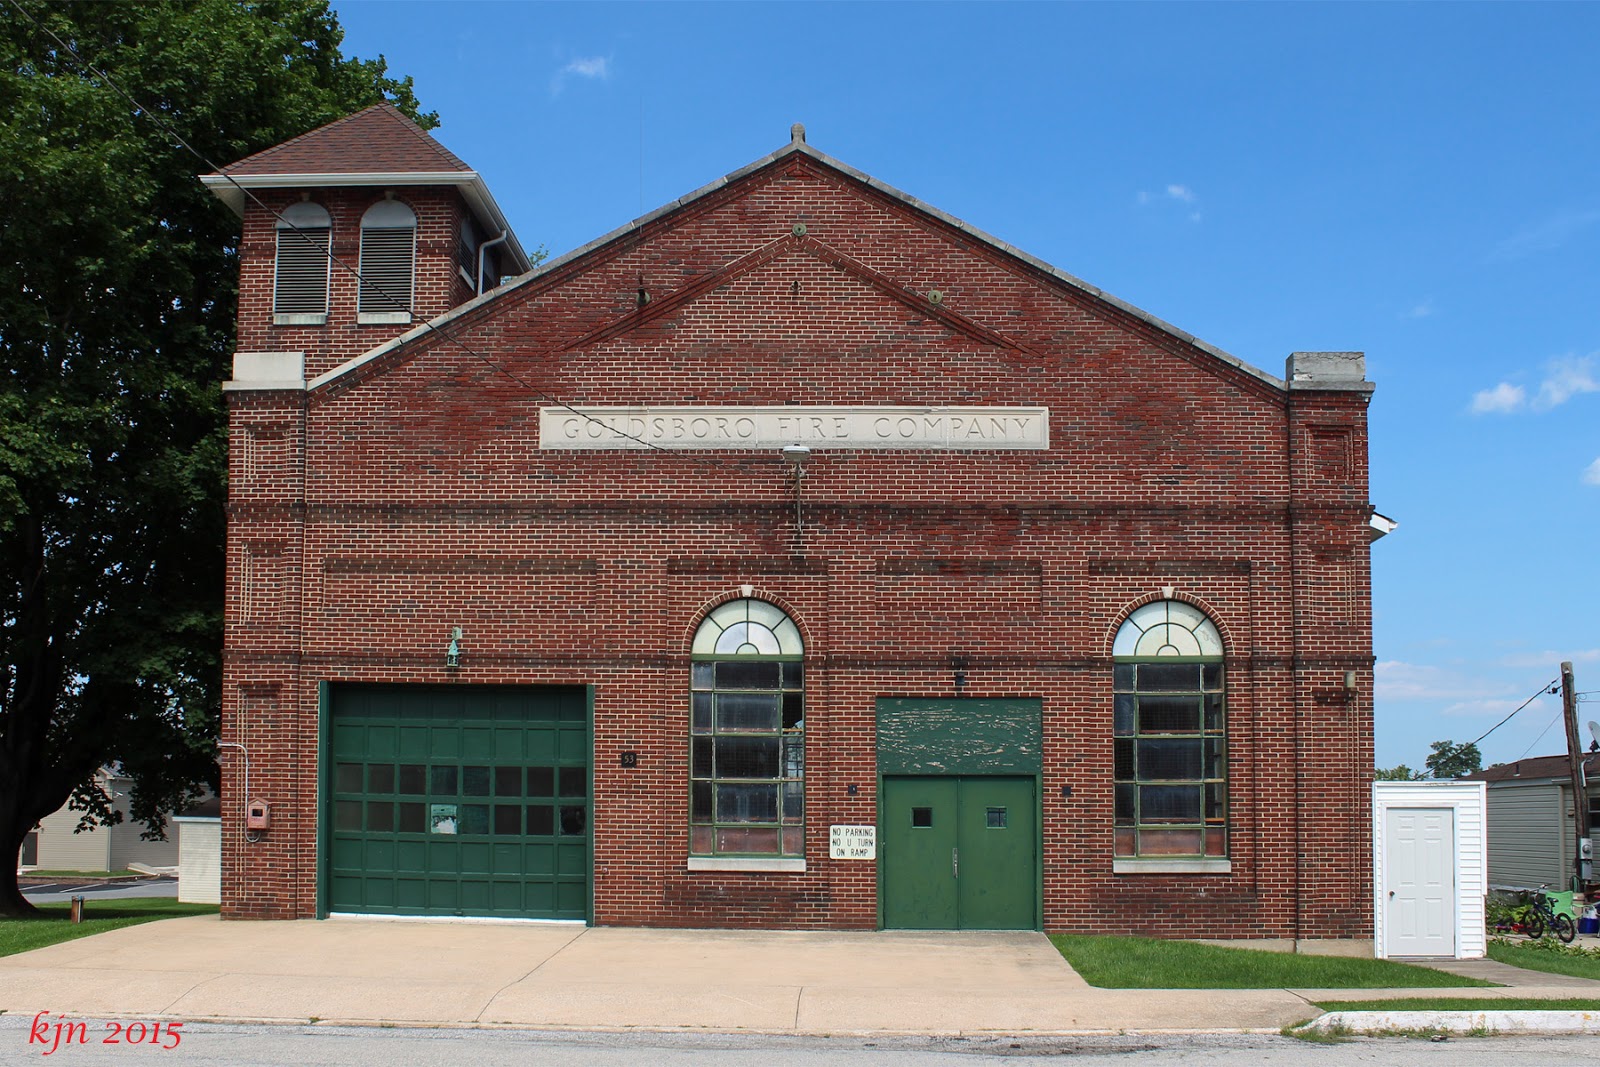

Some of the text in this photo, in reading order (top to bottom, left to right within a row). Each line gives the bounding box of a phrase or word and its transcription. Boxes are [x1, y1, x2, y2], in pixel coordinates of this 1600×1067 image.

[562, 417, 1031, 439] GOLDSBORO FIRE COMPANY
[624, 755, 634, 764] 53
[832, 828, 873, 837] NO PARKING
[832, 838, 874, 847] NO U TURN
[836, 848, 869, 857] ON RAMP
